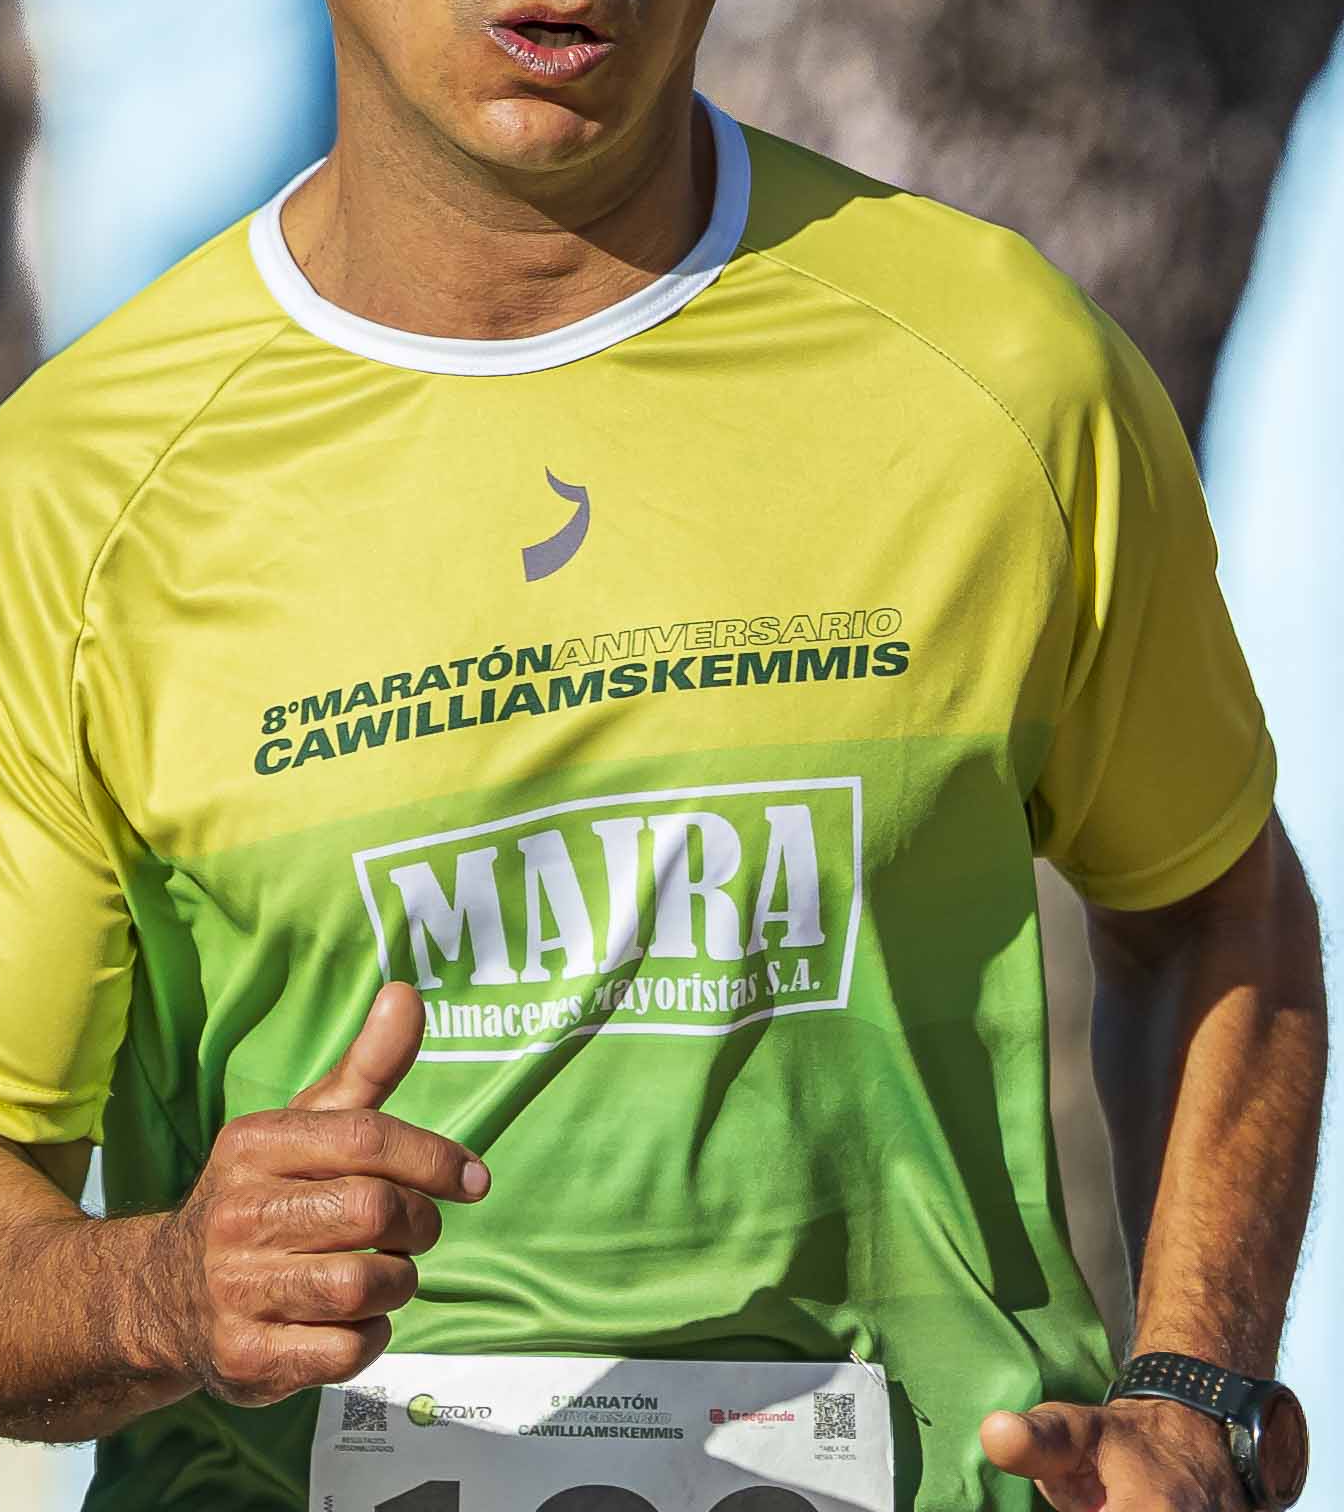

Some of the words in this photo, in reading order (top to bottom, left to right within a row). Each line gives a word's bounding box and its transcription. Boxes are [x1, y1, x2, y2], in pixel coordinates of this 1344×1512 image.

[253, 641, 910, 777] CAWILLIAMSKEMMIS
[389, 805, 825, 990] MAIRA
[589, 973, 758, 1015] Mayoristas
[766, 958, 822, 996] S.A.
[518, 1424, 684, 1439] CAWILLIAMSKEMMIS
